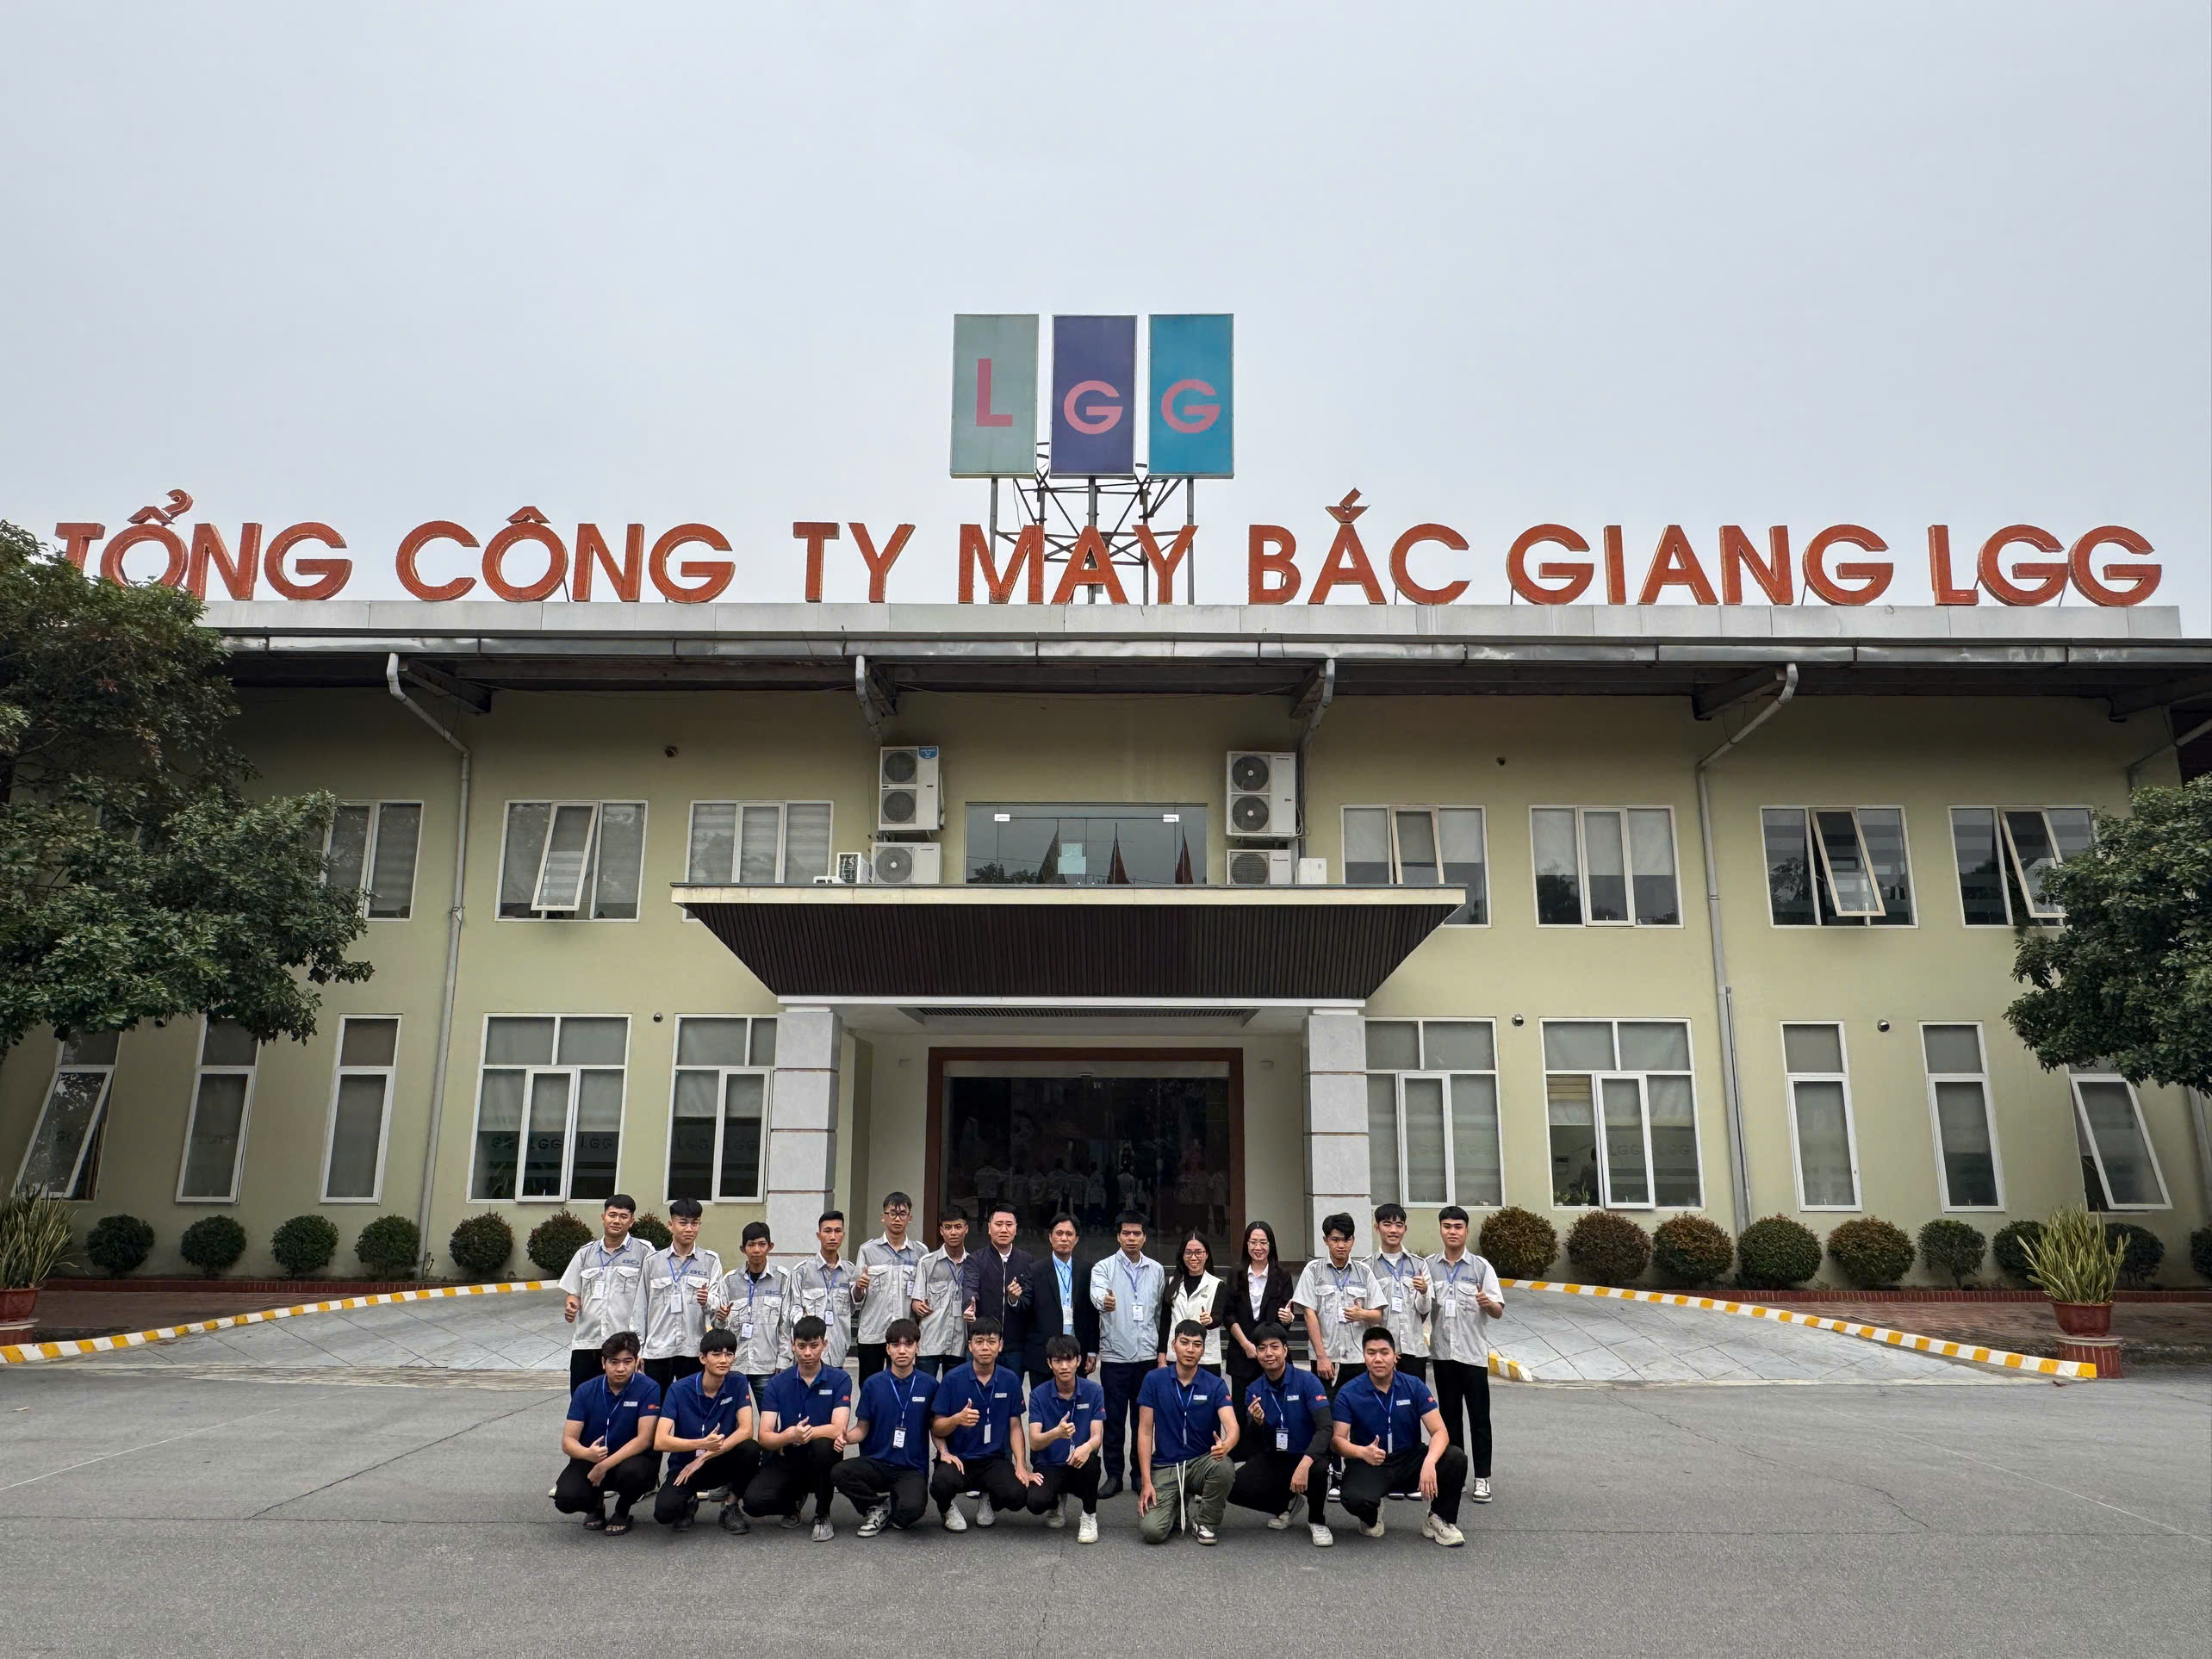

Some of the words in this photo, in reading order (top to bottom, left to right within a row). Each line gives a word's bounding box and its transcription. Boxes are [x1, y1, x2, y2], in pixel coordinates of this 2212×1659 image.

[55, 488, 353, 601] TỔNG
[395, 506, 736, 603] CÔNG
[792, 521, 916, 603] TY
[958, 523, 1199, 605] MAY
[1248, 487, 1471, 605] BẮC
[1506, 523, 1894, 606] GIANG
[1927, 524, 2163, 606] LGG
